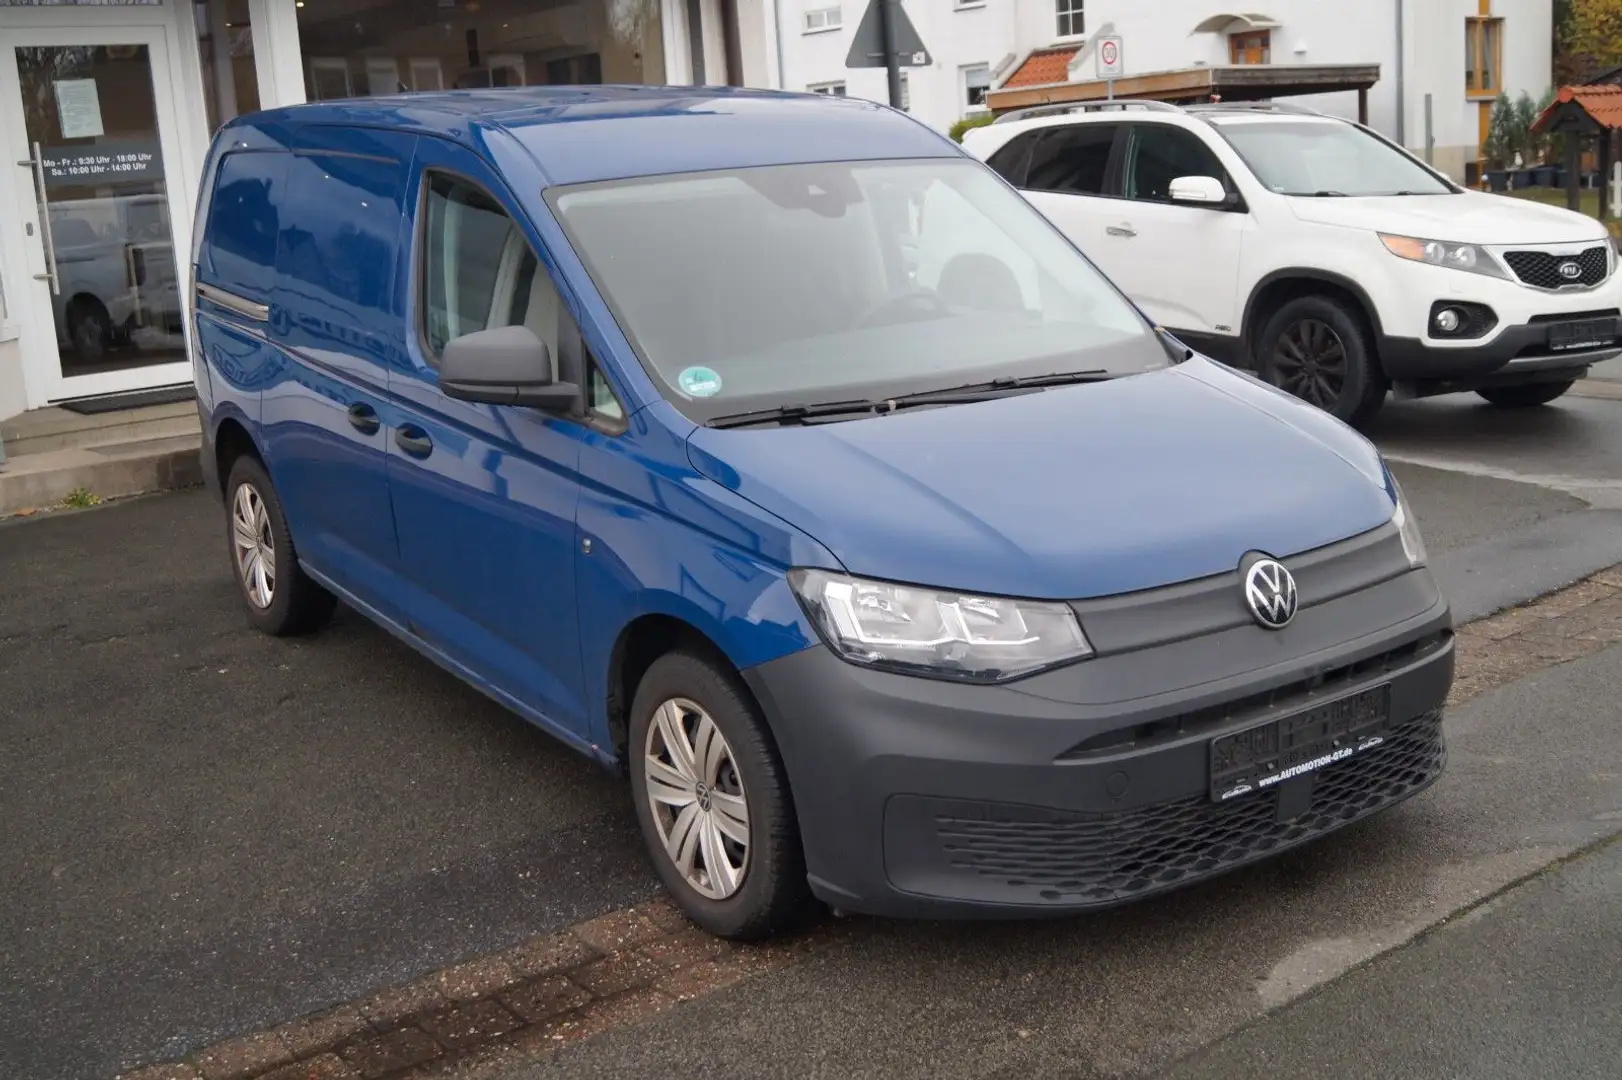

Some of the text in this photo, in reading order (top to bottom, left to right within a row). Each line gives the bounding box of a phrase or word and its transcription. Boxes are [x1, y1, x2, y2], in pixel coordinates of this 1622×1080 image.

[96, 156, 111, 164] Uhr
[138, 153, 152, 161] Uhr
[69, 167, 89, 175] 10:00
[91, 165, 106, 173] Uhr
[111, 163, 131, 172] 14:00
[132, 162, 146, 171] Uhr
